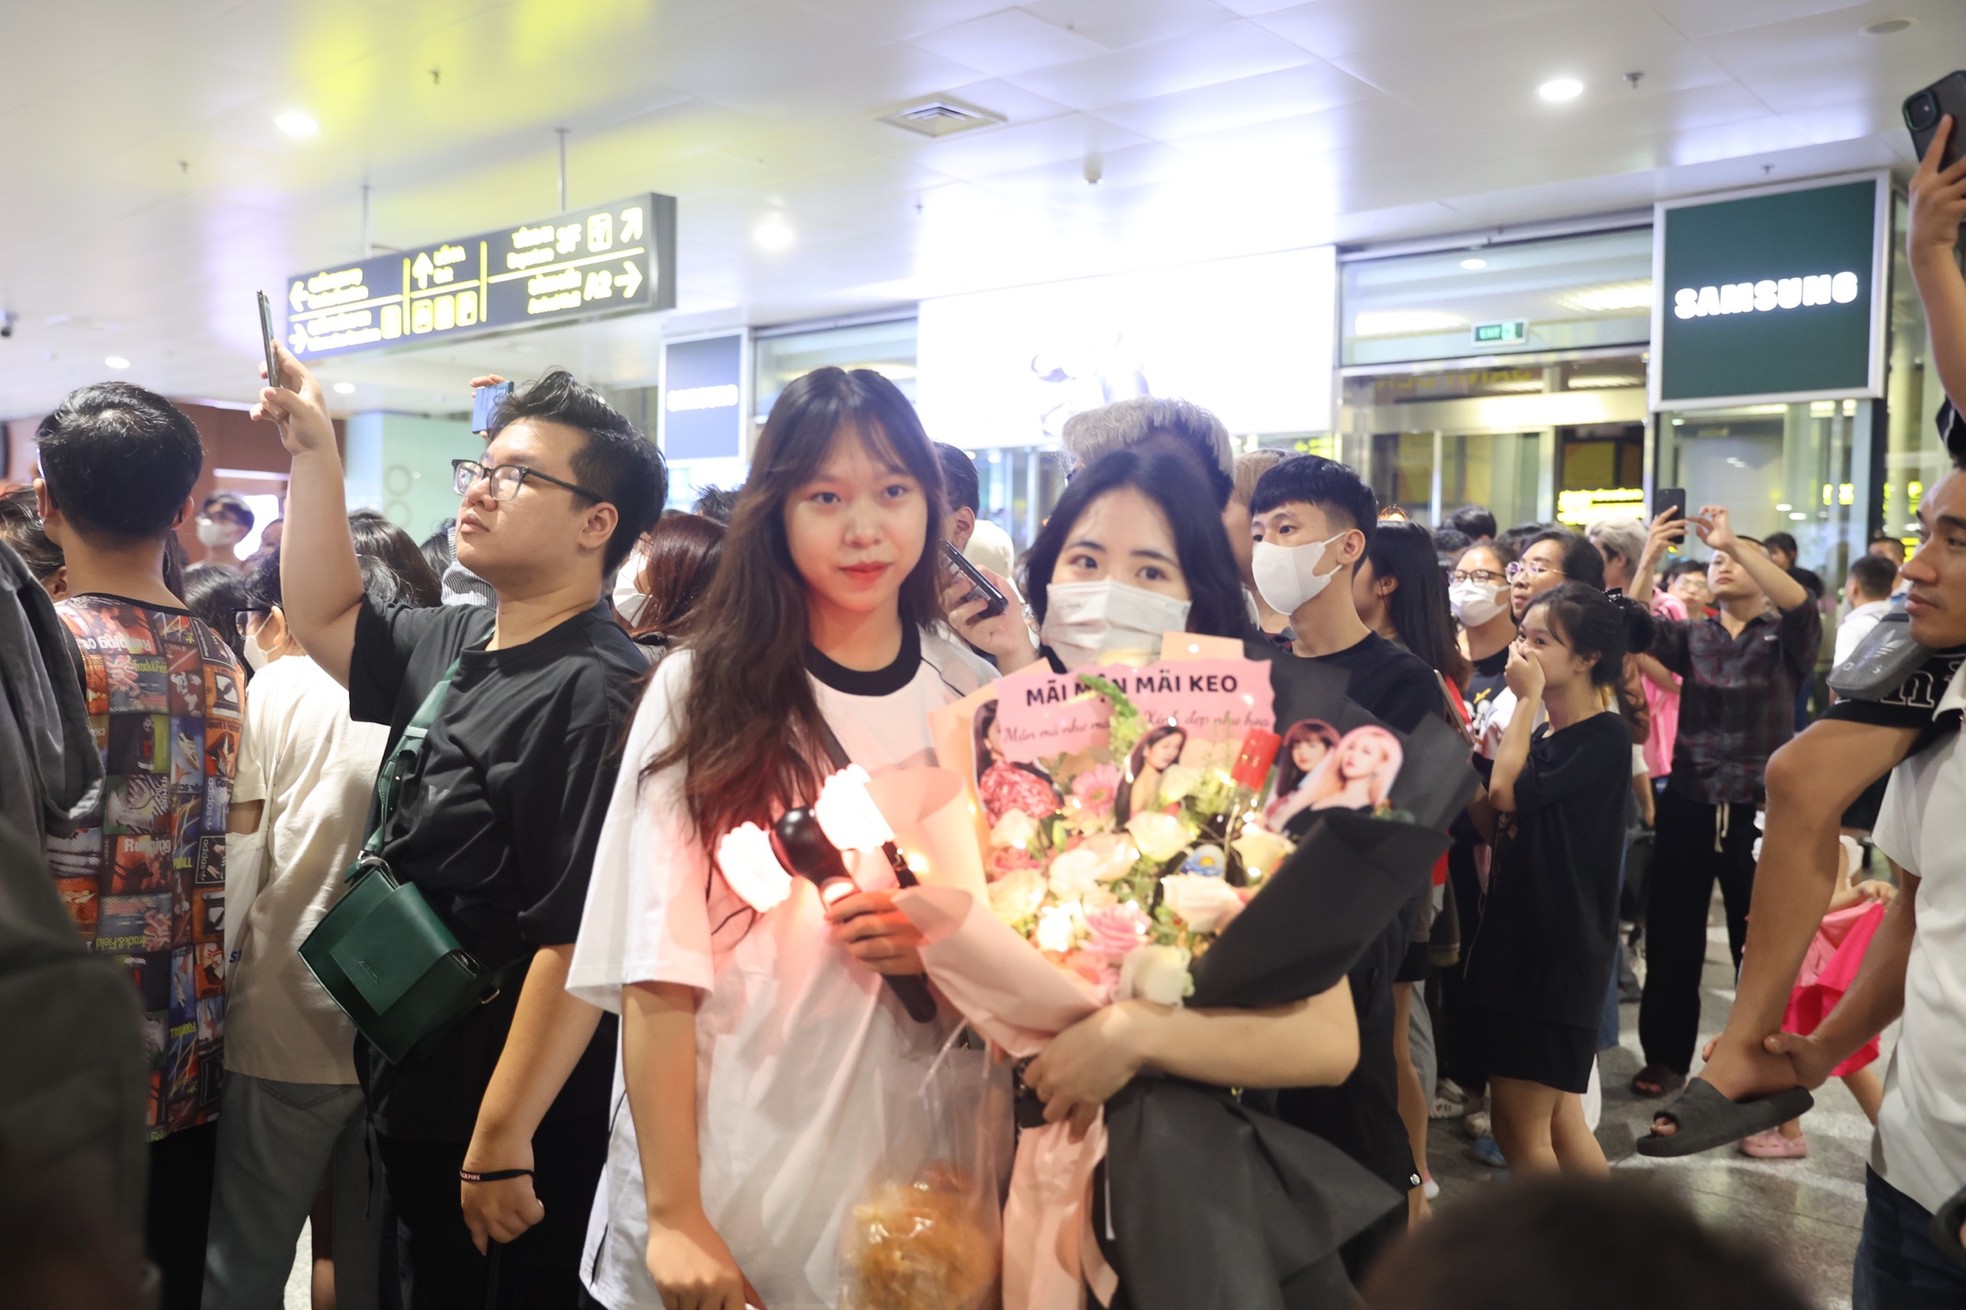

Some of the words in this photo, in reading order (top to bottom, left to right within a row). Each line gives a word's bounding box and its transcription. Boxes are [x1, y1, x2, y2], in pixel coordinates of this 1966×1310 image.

[1674, 271, 1858, 320] SAMSUNG
[1026, 679, 1066, 706] MÃI
[1188, 674, 1237, 693] KEO
